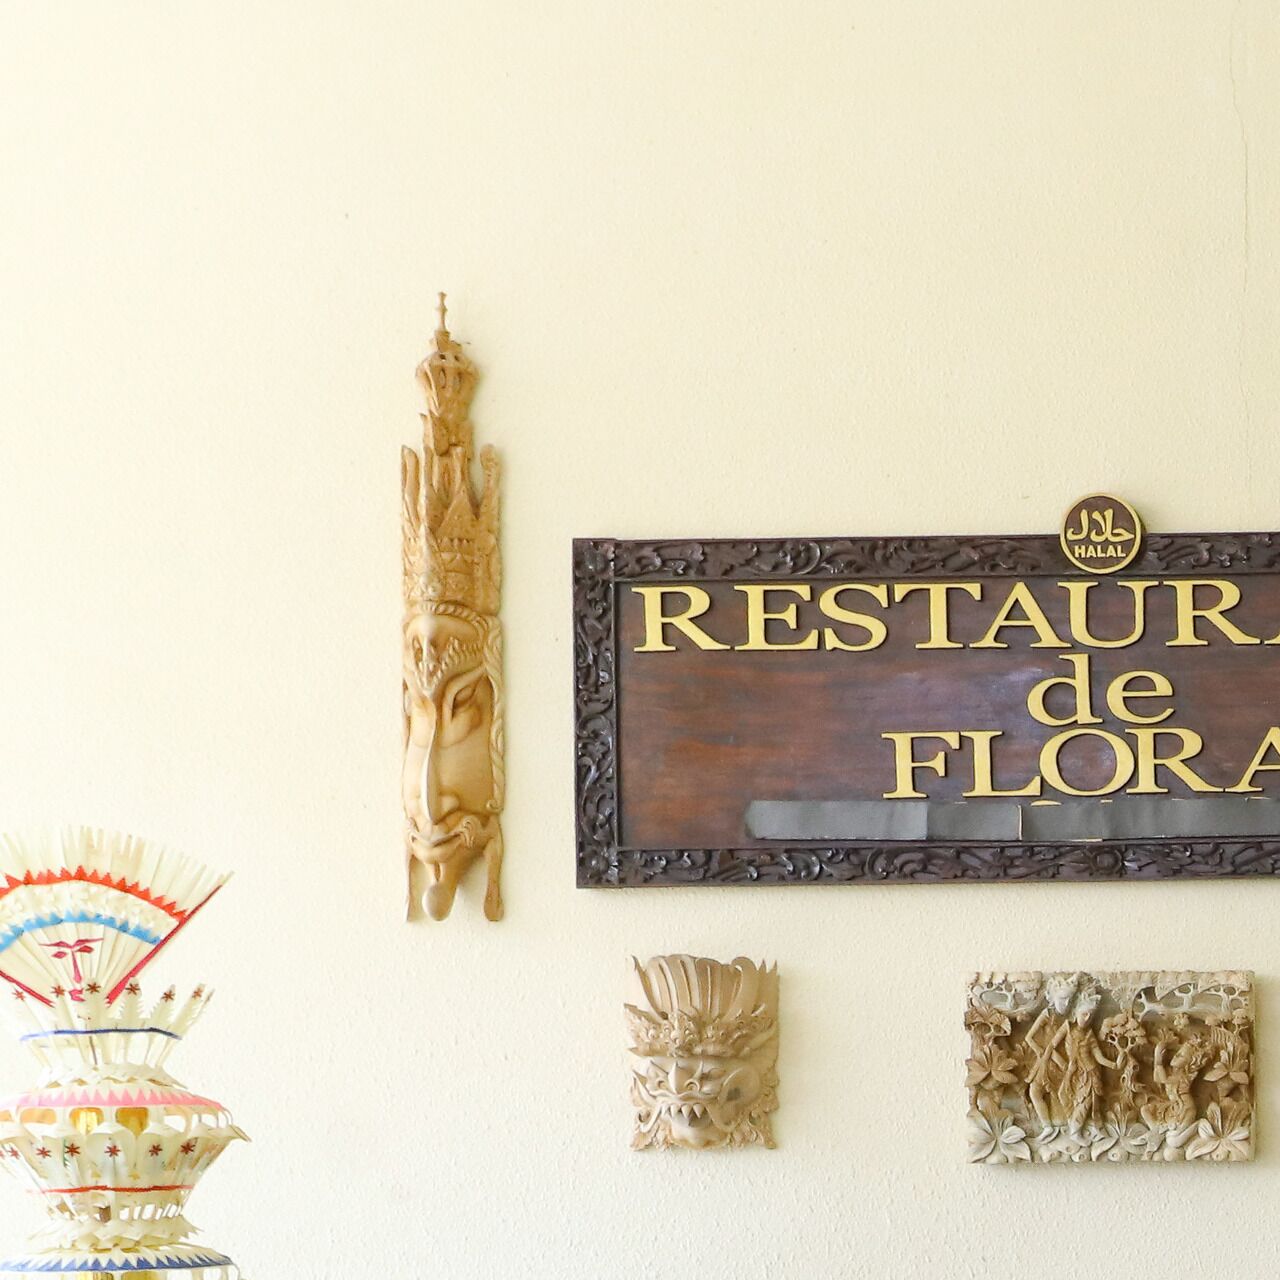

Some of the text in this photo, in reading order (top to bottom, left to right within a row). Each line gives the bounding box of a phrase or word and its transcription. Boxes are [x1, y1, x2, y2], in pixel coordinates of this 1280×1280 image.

[1066, 508, 1135, 542] حلال
[1074, 545, 1126, 558] HALAL
[1026, 653, 1176, 726] de
